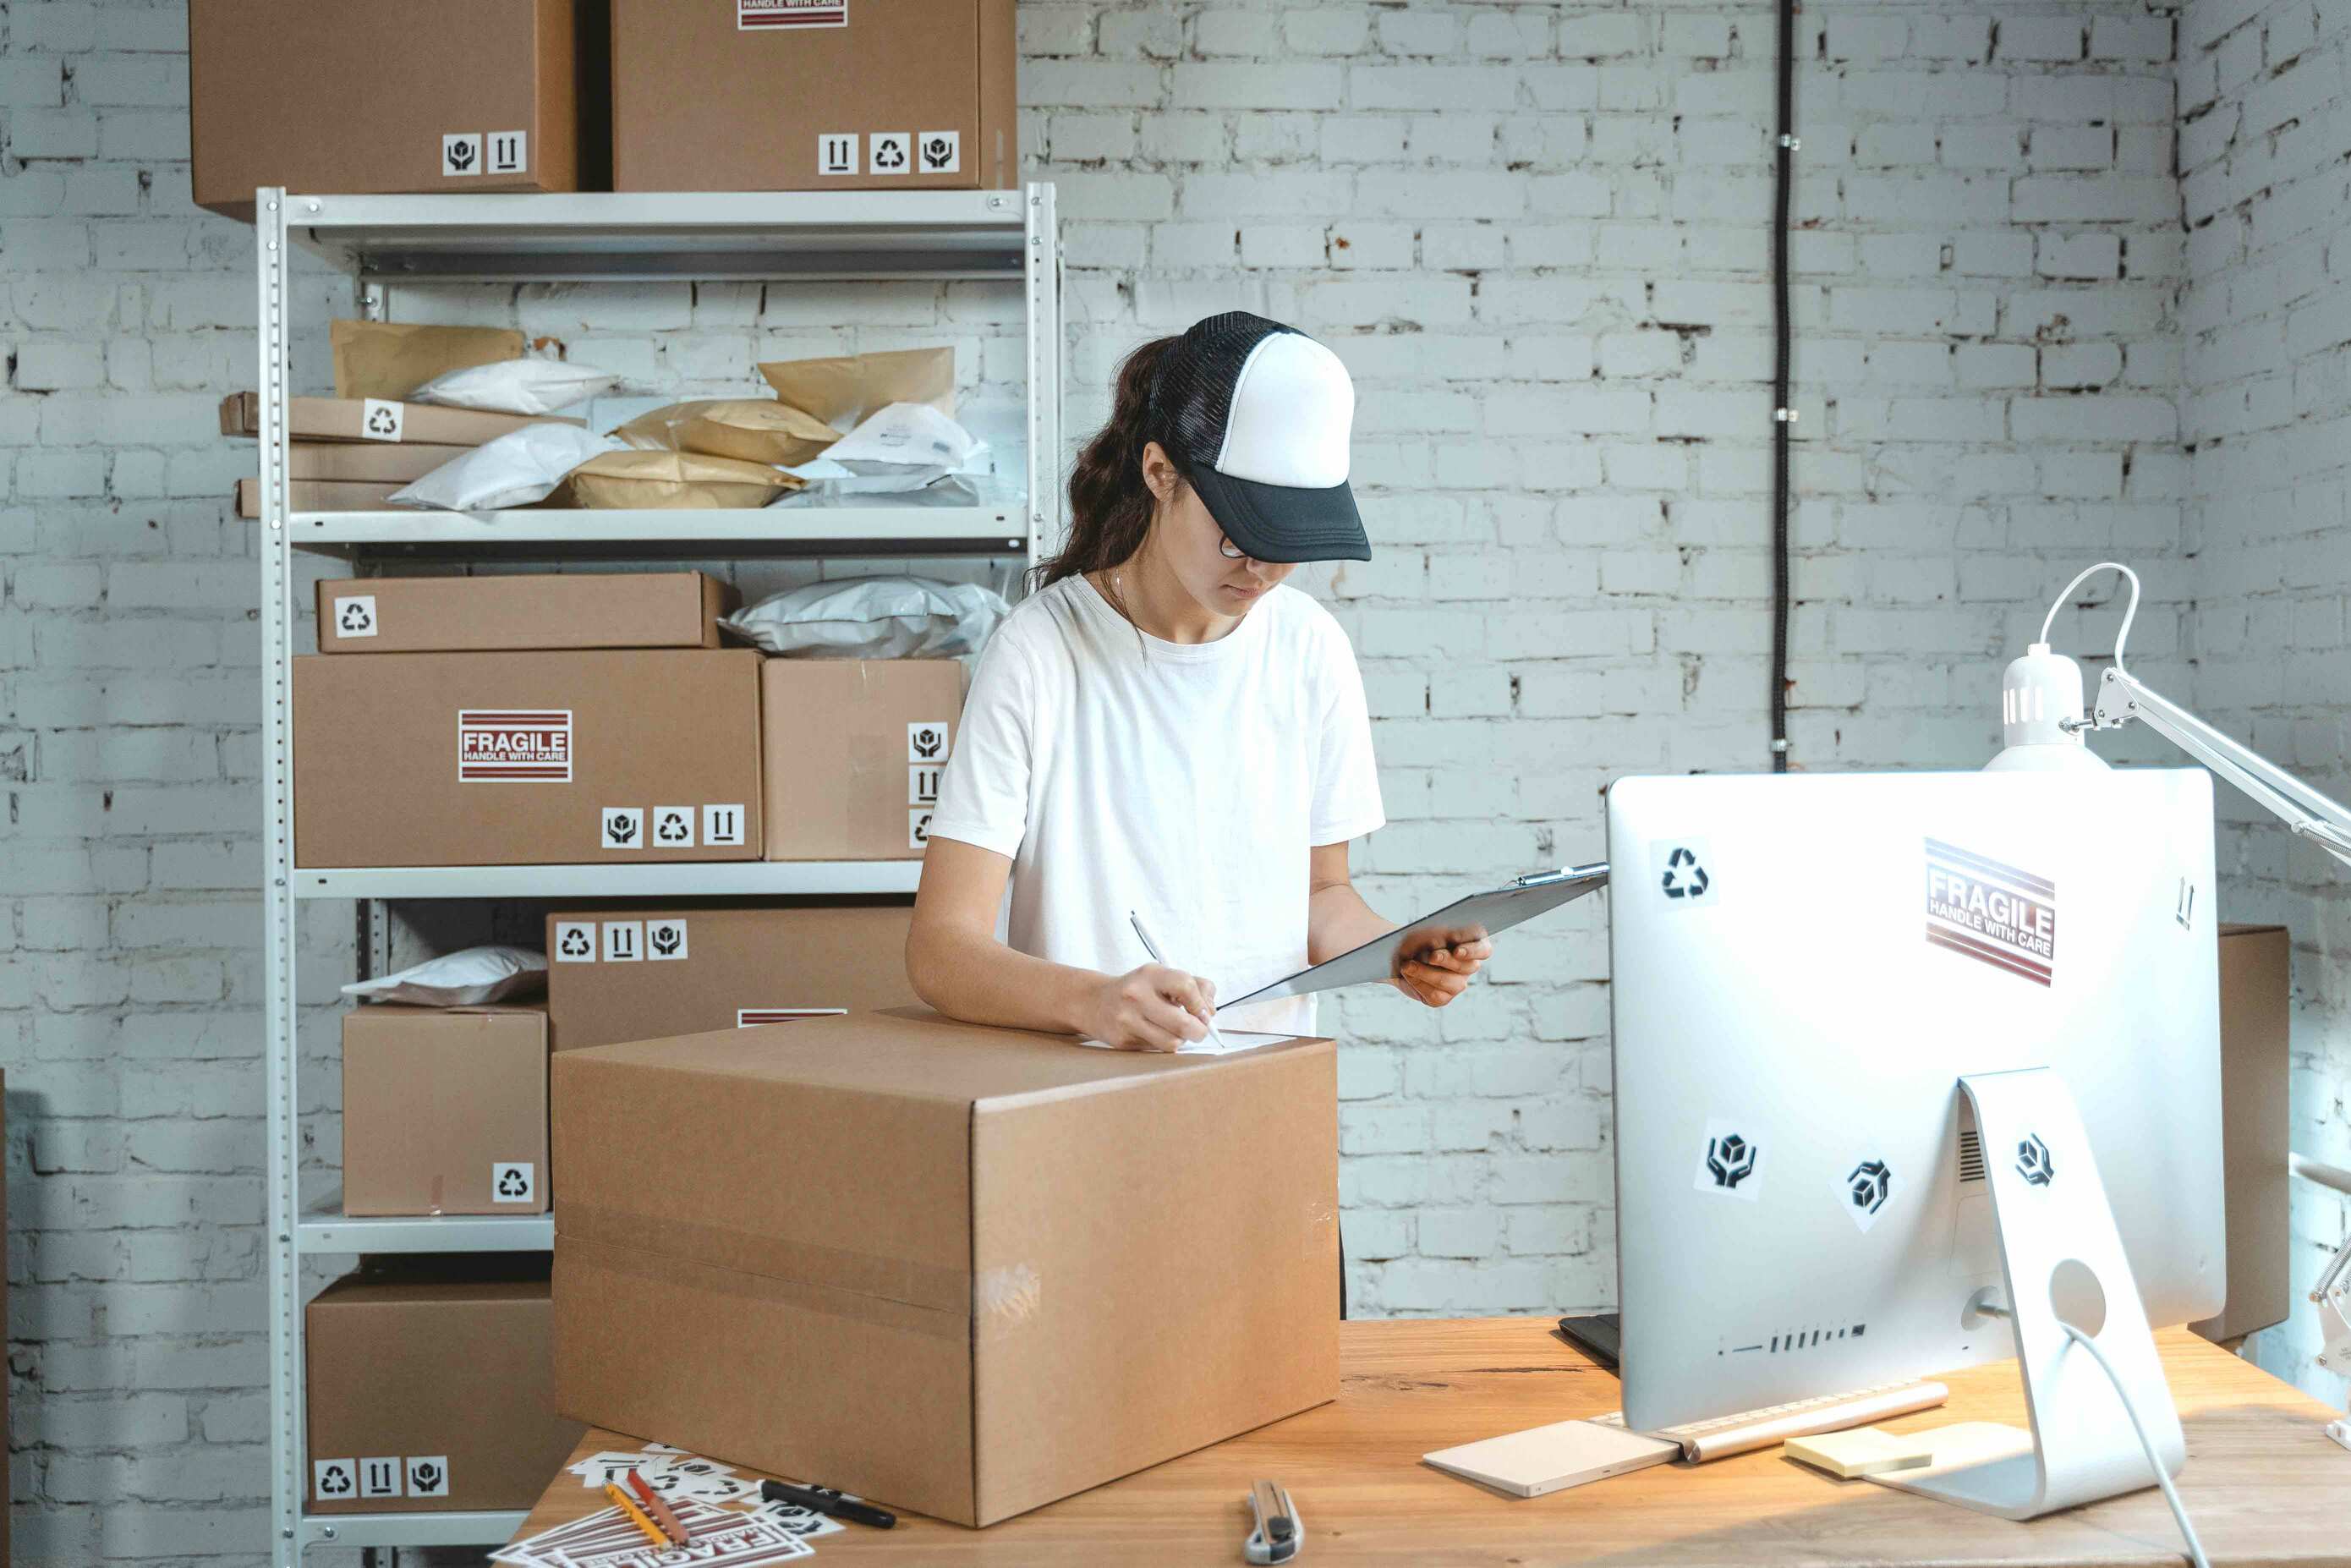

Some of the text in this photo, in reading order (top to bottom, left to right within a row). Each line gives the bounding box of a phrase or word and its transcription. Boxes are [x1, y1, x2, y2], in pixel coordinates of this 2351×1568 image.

[463, 732, 566, 752] FRAGILE
[463, 751, 566, 761] HANDLE WITH CARE
[1929, 868, 2052, 941] FRAGILE
[1930, 899, 2052, 956] HANDLE WITH CARE
